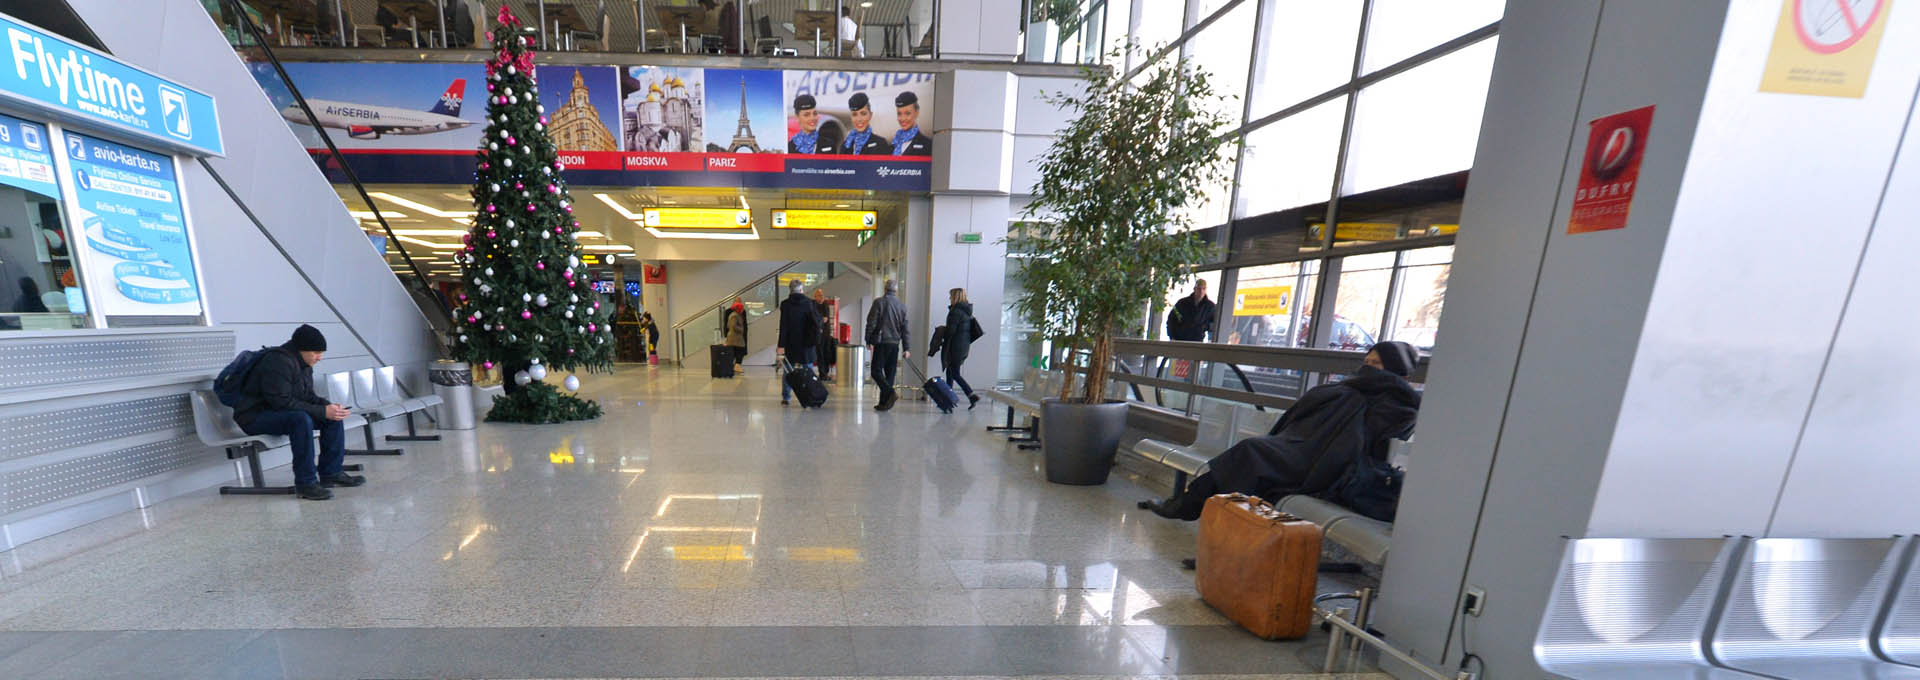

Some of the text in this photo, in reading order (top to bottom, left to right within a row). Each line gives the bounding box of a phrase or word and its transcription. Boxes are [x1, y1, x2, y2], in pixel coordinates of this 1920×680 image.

[8, 28, 146, 115] Flytime
[76, 99, 150, 128] www.avio-karte.rs
[326, 105, 380, 120] AirSERBIA
[93, 146, 161, 172] avio-karte.rs
[557, 155, 585, 166] NDON
[627, 156, 668, 167] MOSKVA
[709, 157, 736, 167] PARIZ
[890, 168, 922, 176] AirSERBIA
[1576, 181, 1632, 200] DUFRY
